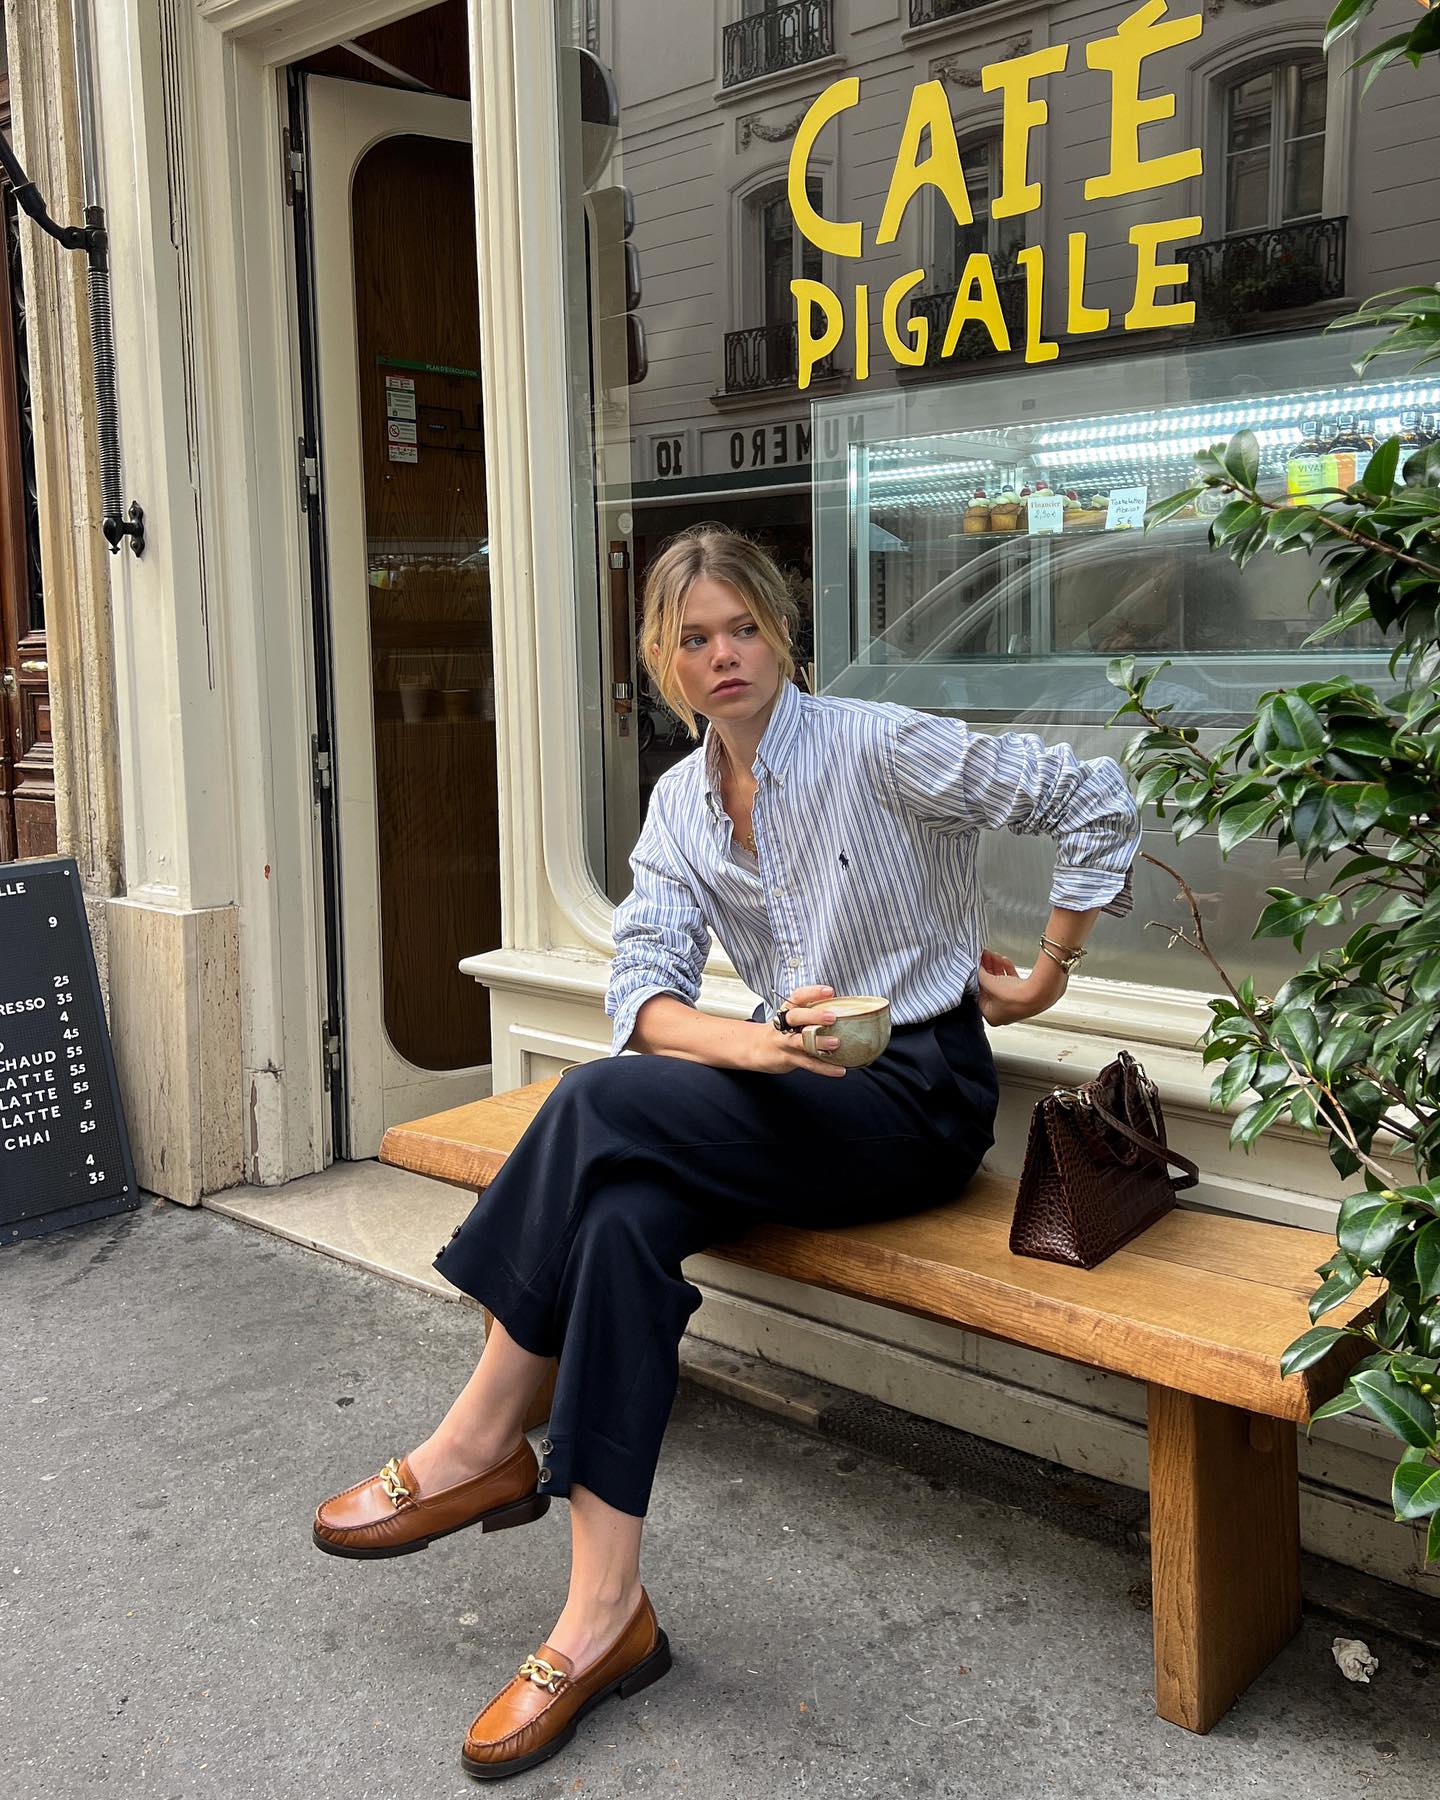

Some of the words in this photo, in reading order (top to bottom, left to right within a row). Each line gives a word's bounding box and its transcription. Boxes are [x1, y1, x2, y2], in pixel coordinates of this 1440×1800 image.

[788, 0, 1203, 258] CAFÉ
[790, 215, 1203, 389] PIGALLE
[48, 916, 59, 928] 9
[60, 1010, 69, 1022] 4
[0, 1087, 58, 1111] LATTE
[1, 1105, 62, 1130] LATTE
[4, 1129, 51, 1151] CHAI
[86, 1153, 95, 1166] 4
